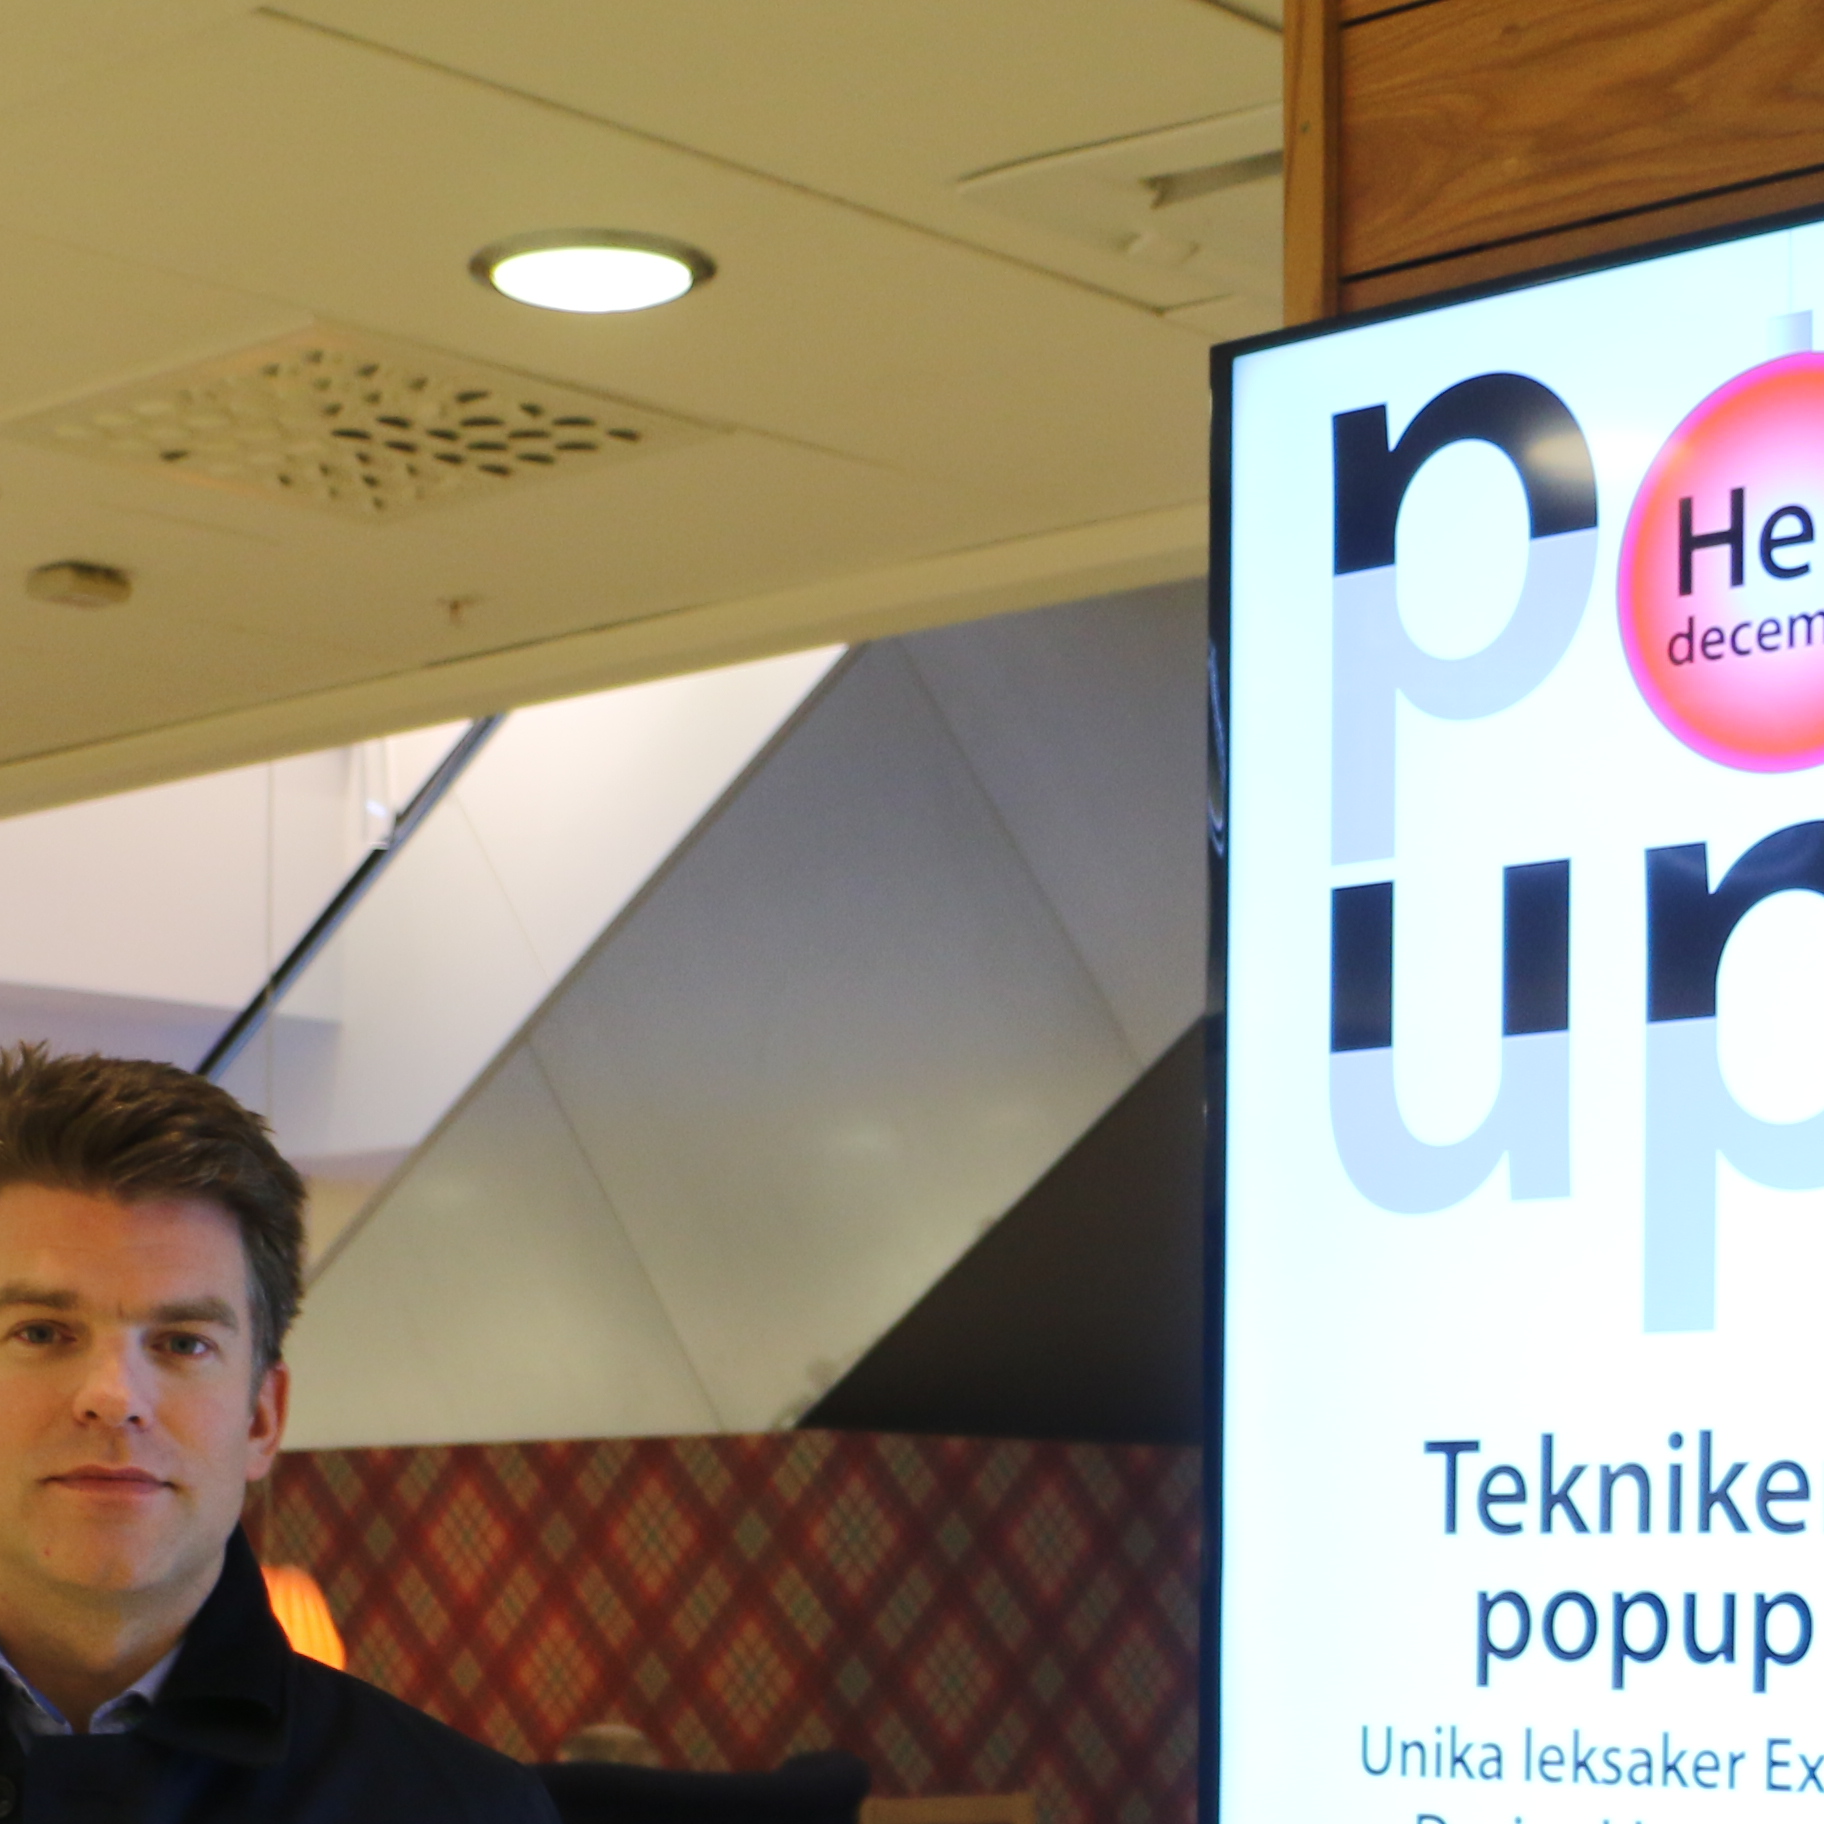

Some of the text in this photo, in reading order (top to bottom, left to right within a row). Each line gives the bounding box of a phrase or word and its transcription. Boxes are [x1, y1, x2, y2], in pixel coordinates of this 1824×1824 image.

[1475, 1589, 1815, 1695] popup
[1360, 1724, 1505, 1782] Unika
[1523, 1726, 1748, 1791] leksaker
